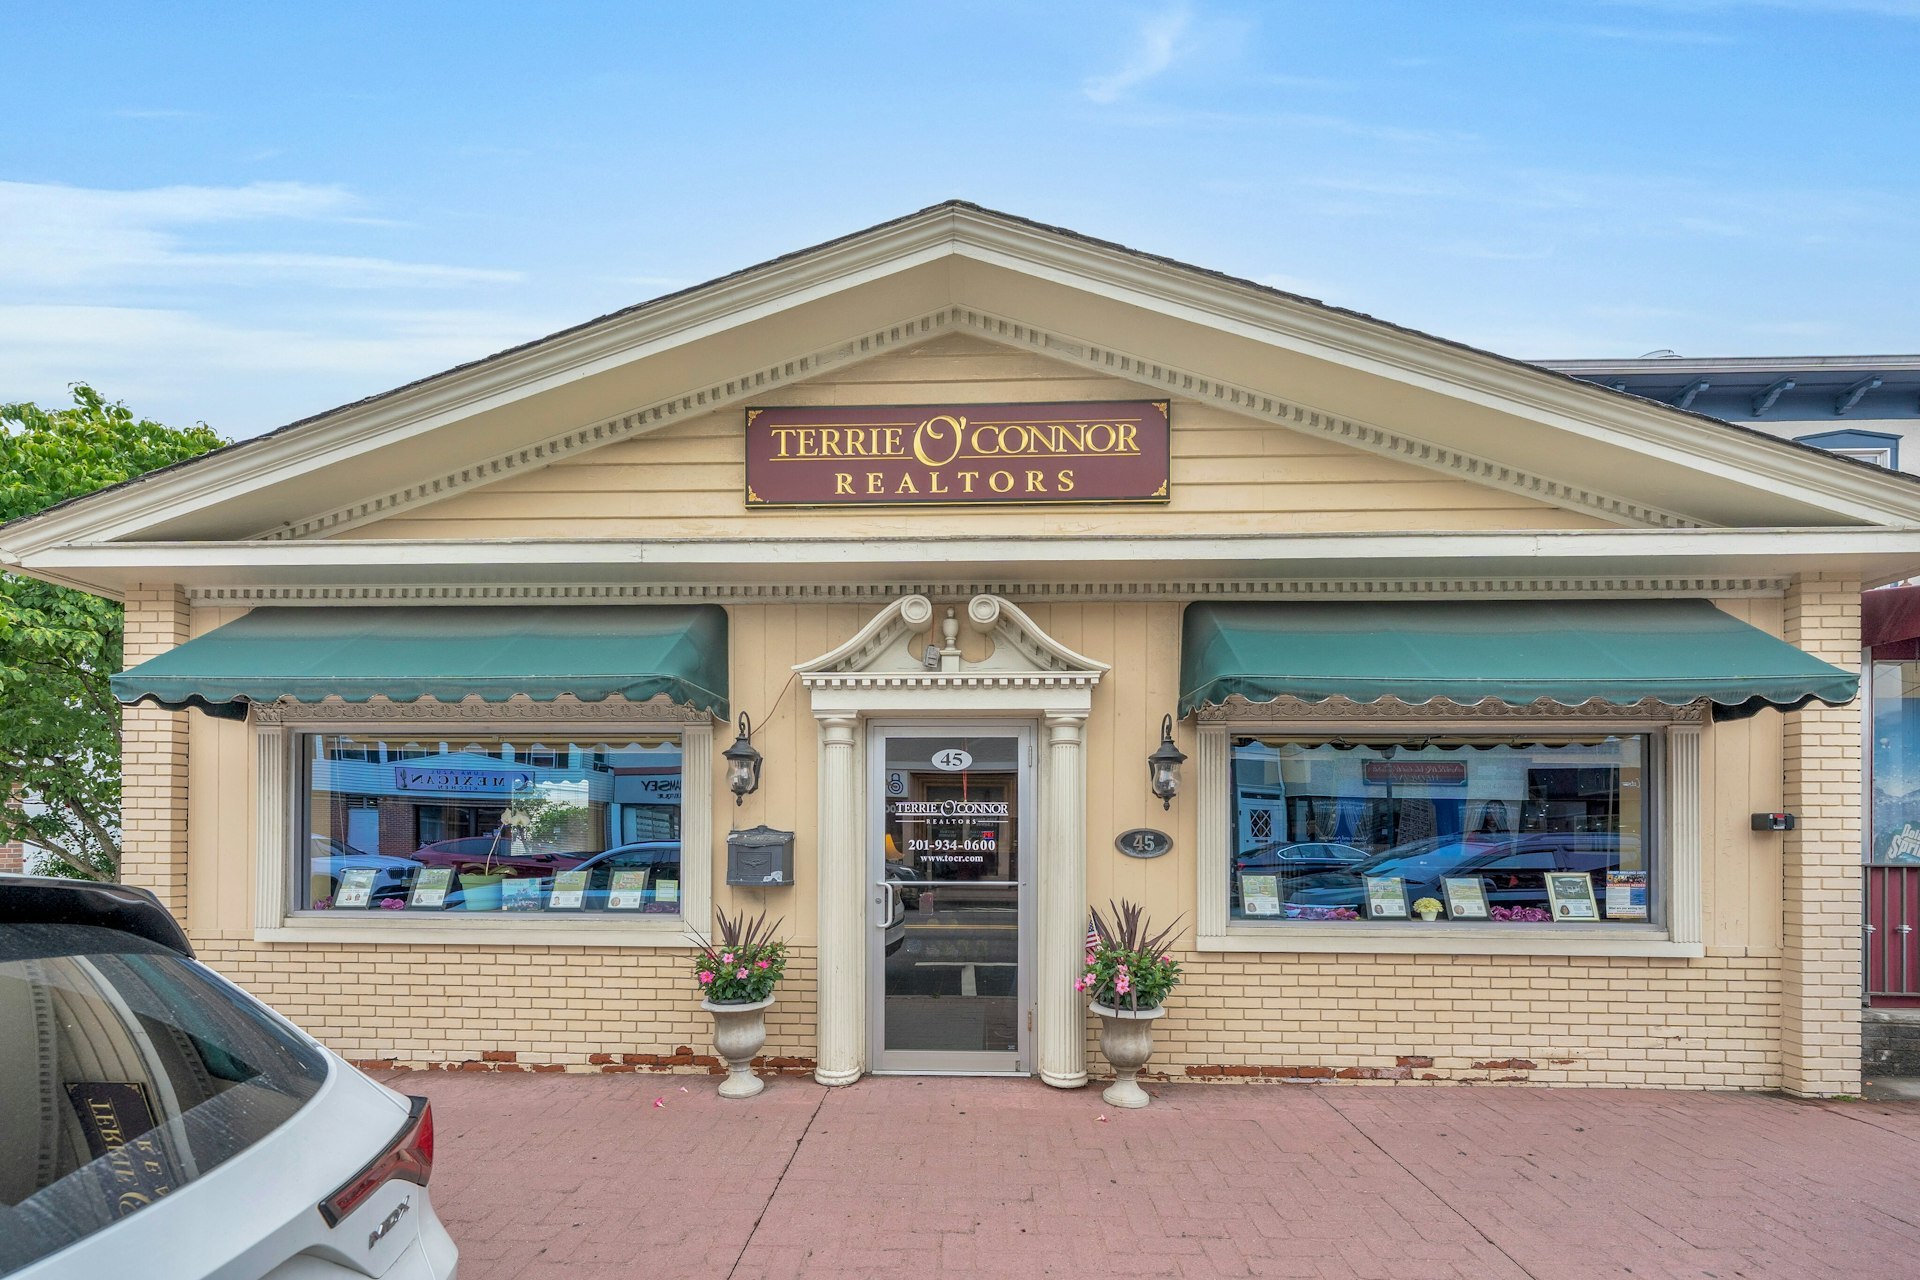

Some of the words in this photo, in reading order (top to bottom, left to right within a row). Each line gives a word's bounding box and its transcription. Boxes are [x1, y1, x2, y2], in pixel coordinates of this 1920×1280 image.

[770, 427, 905, 457] TERRIE
[834, 470, 1074, 495] REALTORS
[940, 752, 963, 767] 45
[896, 803, 938, 813] TERRIE
[908, 839, 996, 851] 201-934-0600
[1133, 834, 1155, 851] 45
[920, 855, 984, 863] www.tocr.com
